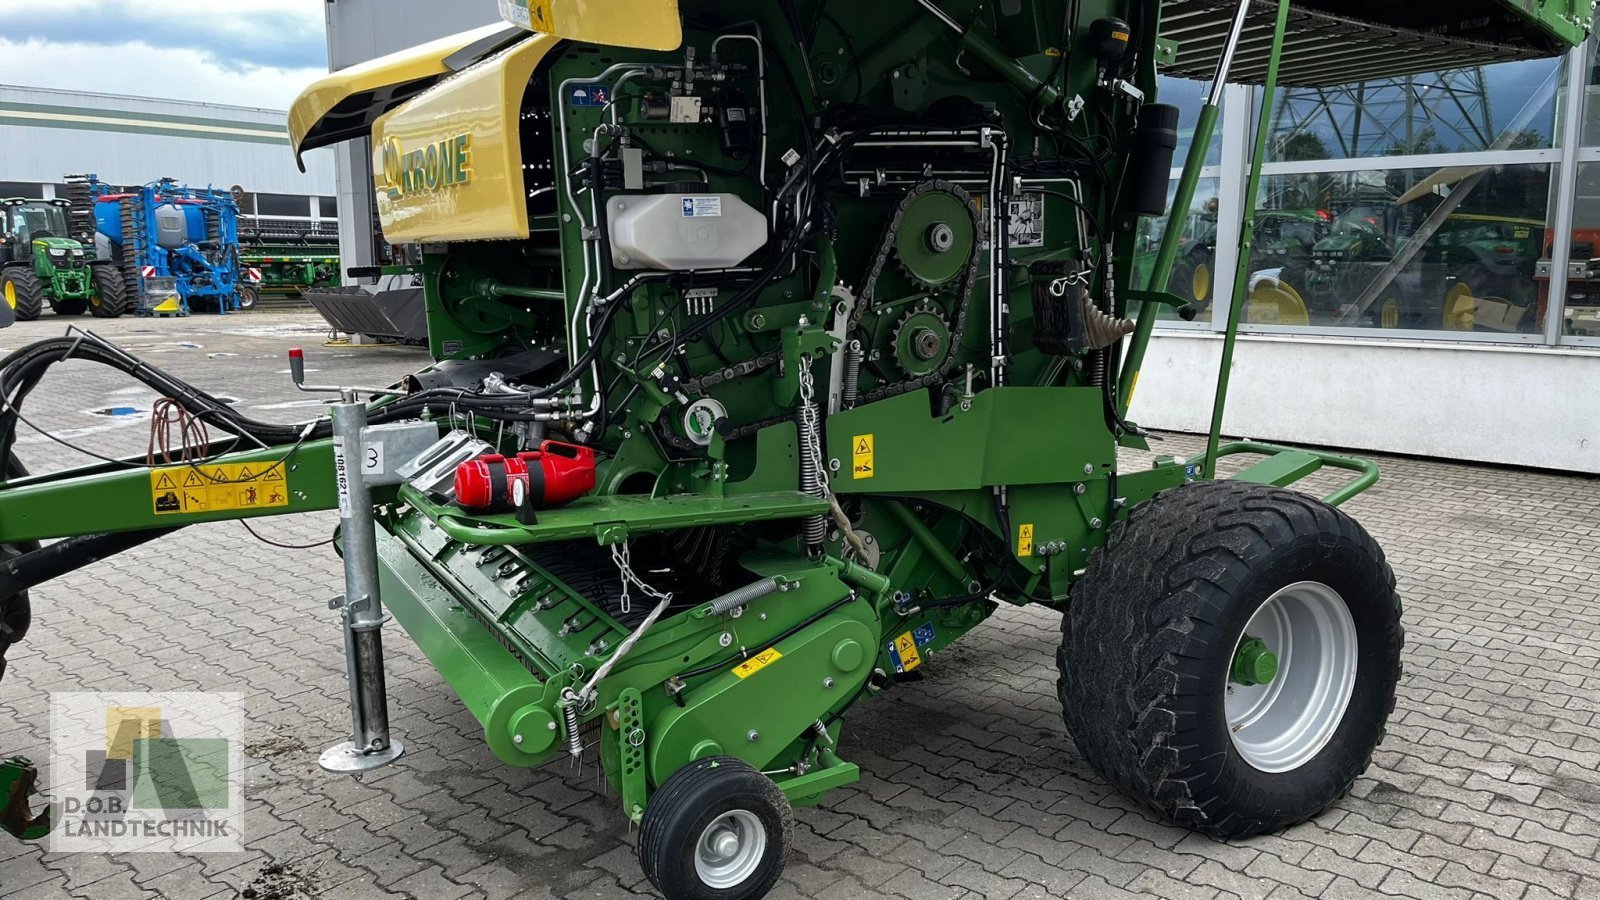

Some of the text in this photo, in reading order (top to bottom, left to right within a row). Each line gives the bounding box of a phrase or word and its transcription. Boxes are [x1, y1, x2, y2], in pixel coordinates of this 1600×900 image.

[401, 131, 470, 194] KRONE
[337, 453, 347, 495] 1081621
[366, 447, 378, 469] 3
